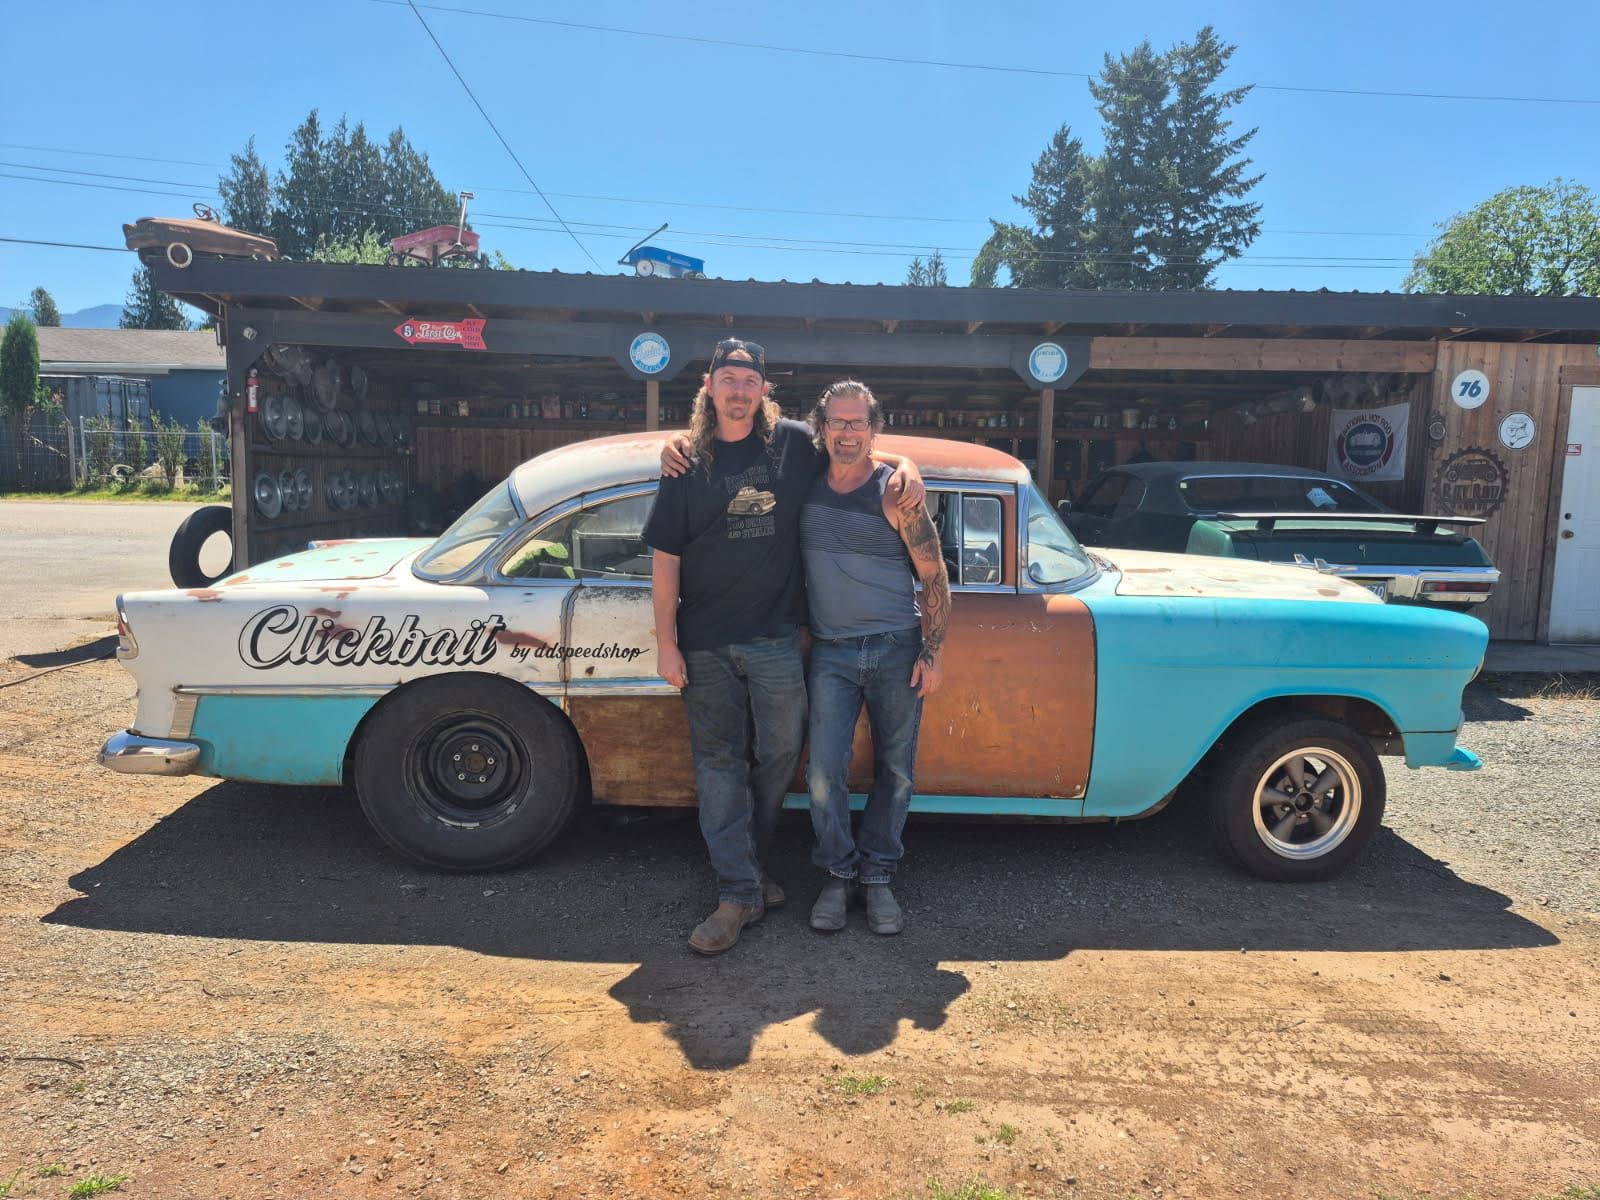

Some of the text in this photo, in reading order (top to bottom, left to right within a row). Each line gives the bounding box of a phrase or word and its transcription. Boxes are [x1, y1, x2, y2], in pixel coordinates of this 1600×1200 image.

[1458, 379, 1482, 398] 76
[1369, 413, 1381, 422] HOT
[238, 603, 506, 670] Clickbait
[509, 642, 531, 663] by
